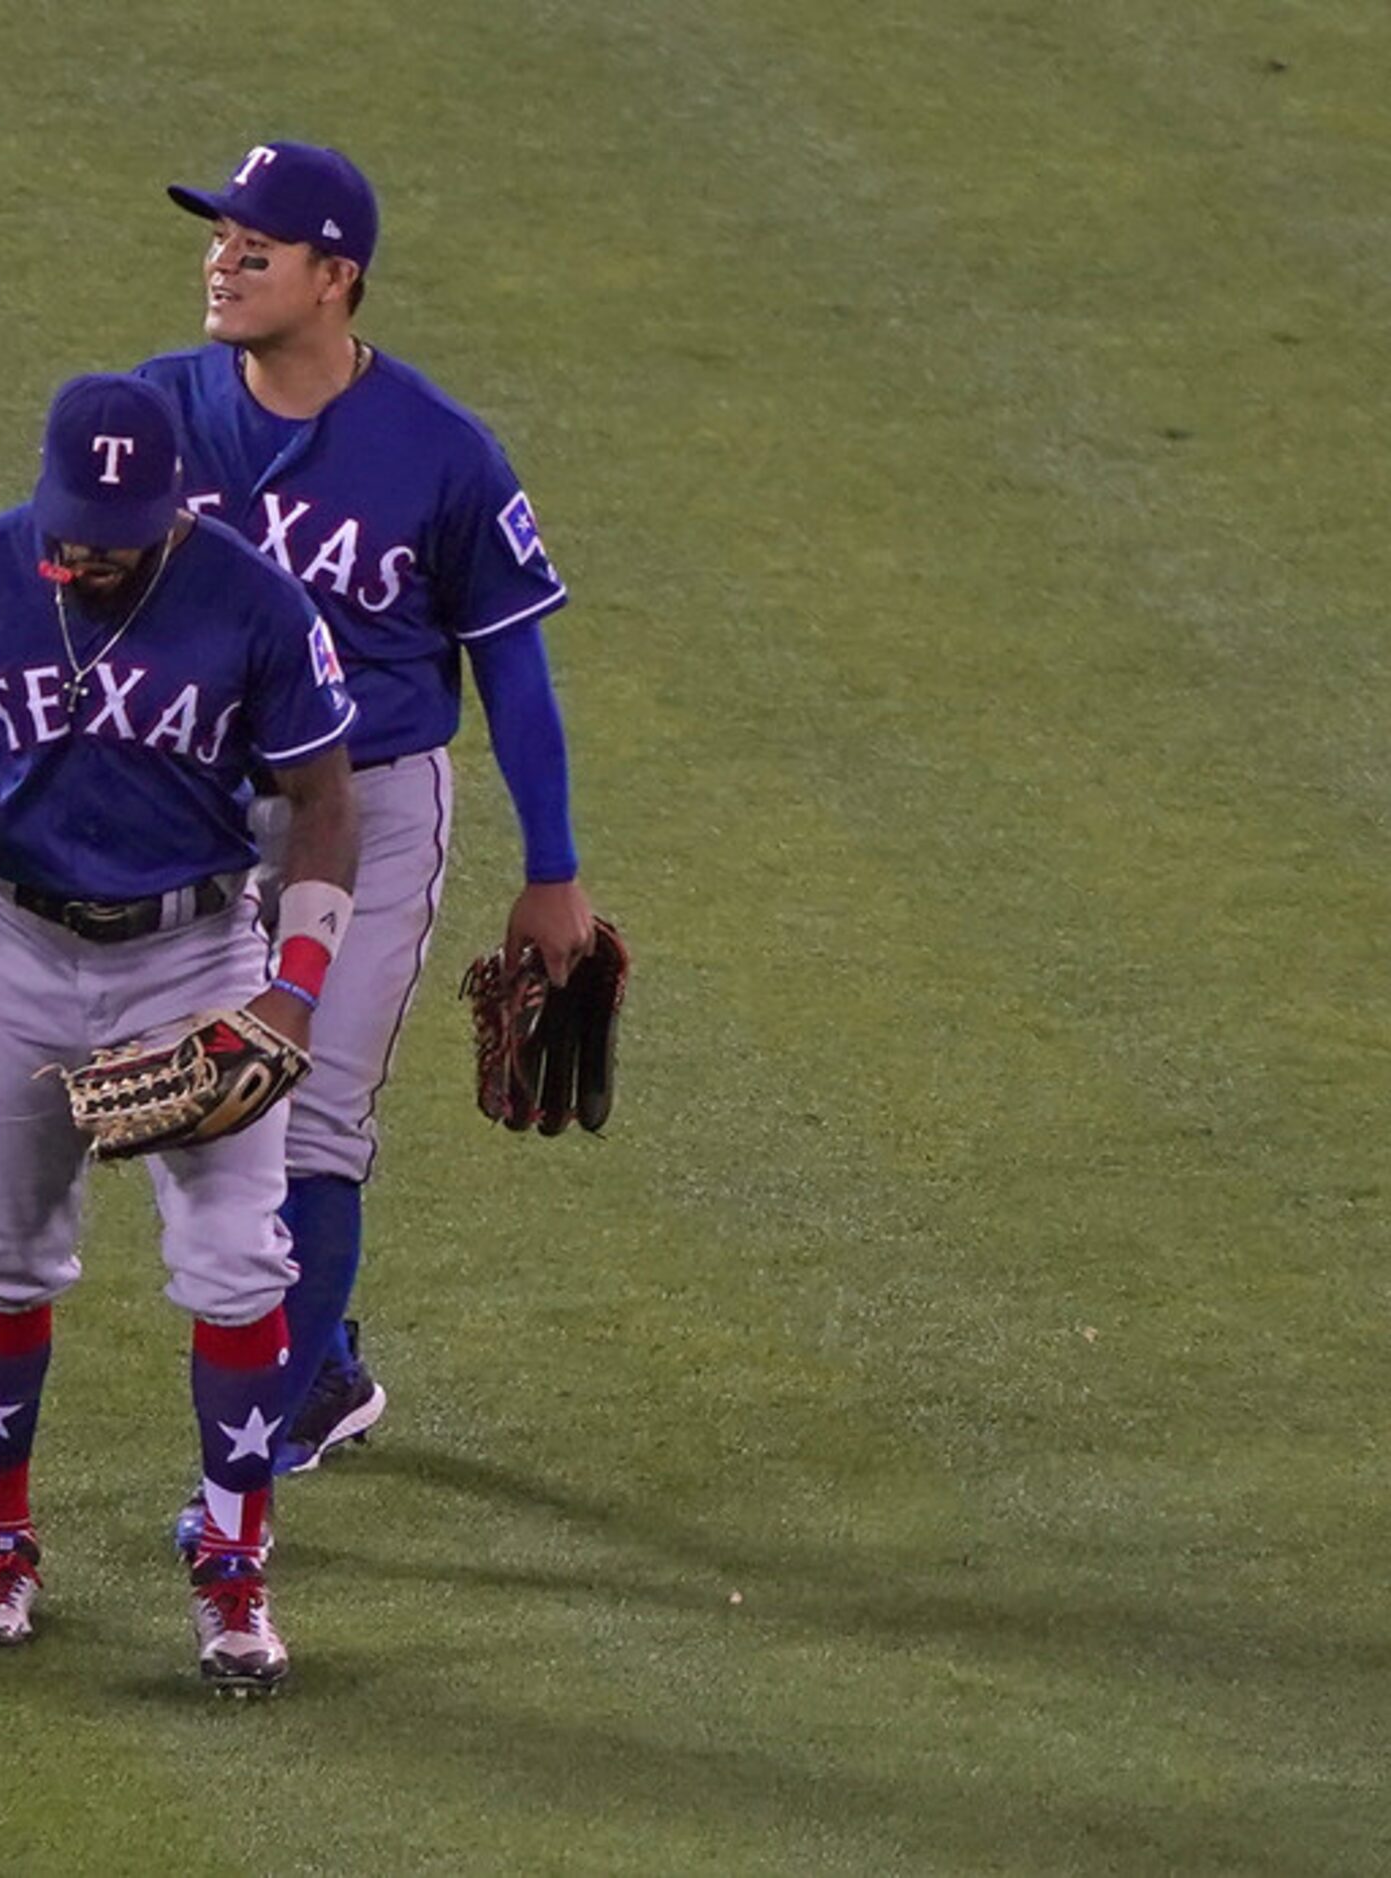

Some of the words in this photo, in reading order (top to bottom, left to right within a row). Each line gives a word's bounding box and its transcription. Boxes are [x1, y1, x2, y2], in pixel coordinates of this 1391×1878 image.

[234, 146, 277, 185] T
[92, 436, 133, 483] T
[186, 492, 416, 612] XAS
